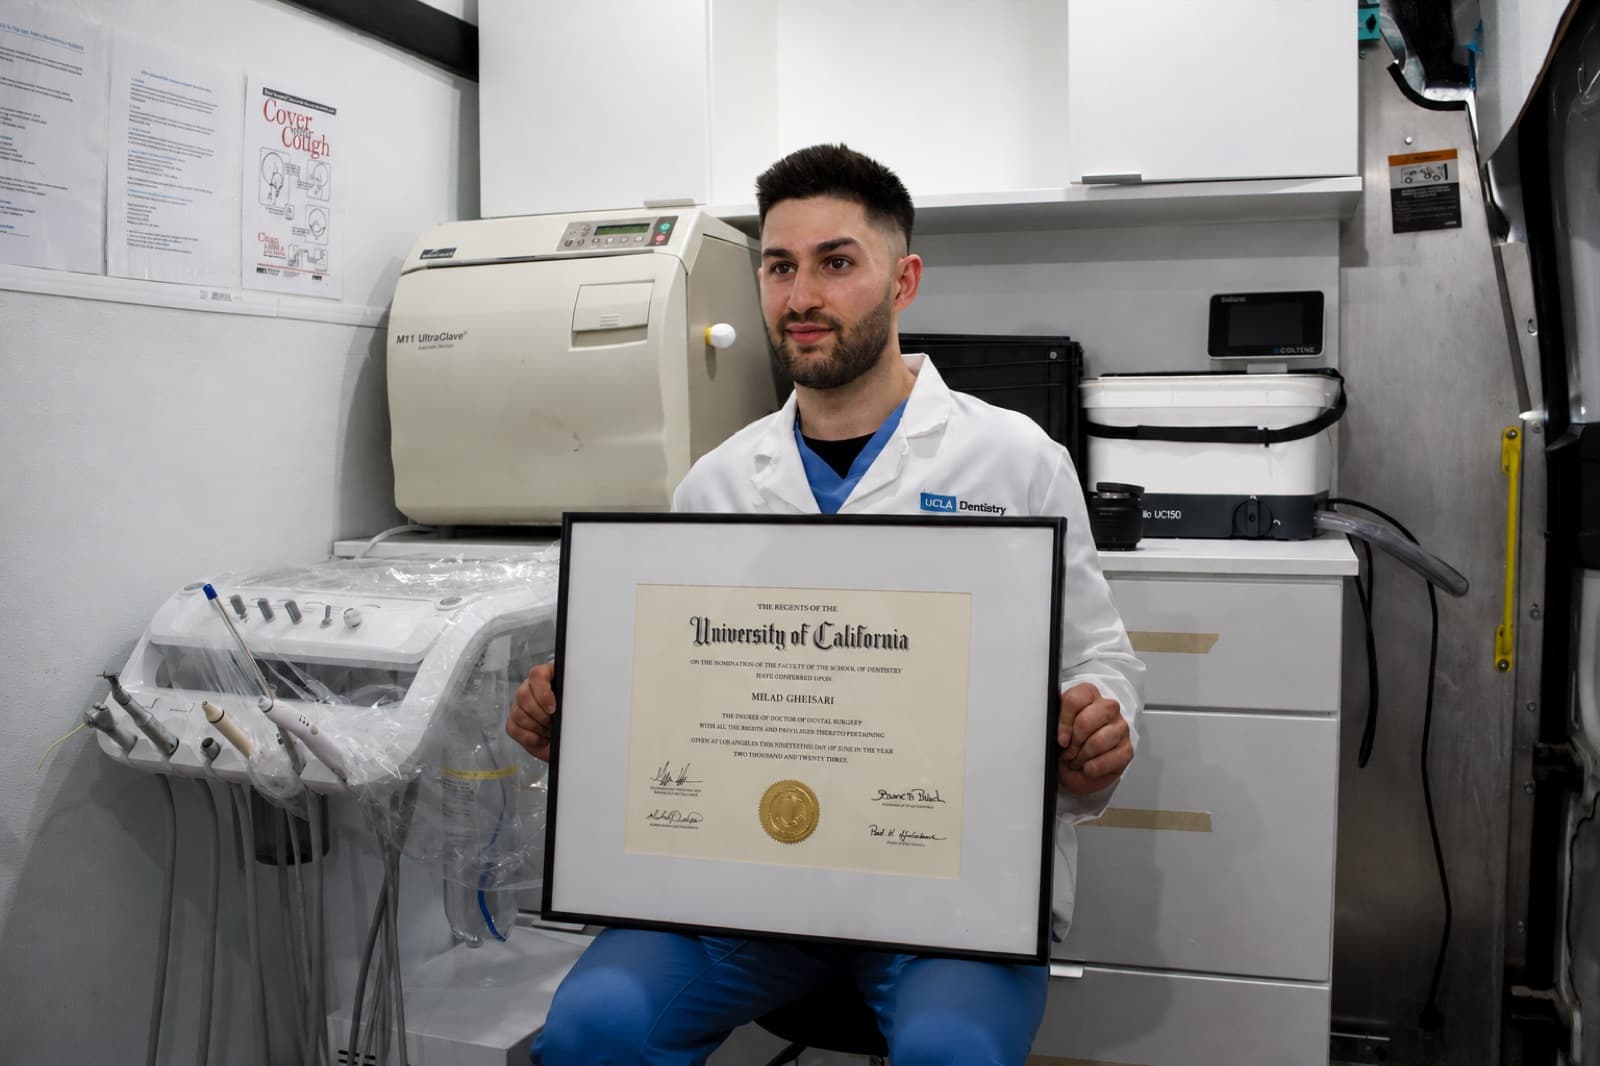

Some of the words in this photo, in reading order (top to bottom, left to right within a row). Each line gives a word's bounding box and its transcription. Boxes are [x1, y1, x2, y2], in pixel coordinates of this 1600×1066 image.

[263, 98, 312, 130] Cover
[281, 126, 330, 159] Cough
[396, 334, 414, 344] M11
[925, 498, 952, 509] UCLA
[959, 501, 1006, 516] Dentistry
[1154, 510, 1182, 519] UC150
[774, 604, 808, 612] REGENTS
[689, 615, 785, 651] University
[790, 622, 811, 647] of
[813, 620, 910, 650] California
[752, 692, 784, 702] MILAD
[786, 694, 834, 704] GHEISARI
[749, 752, 784, 760] THOUSAND
